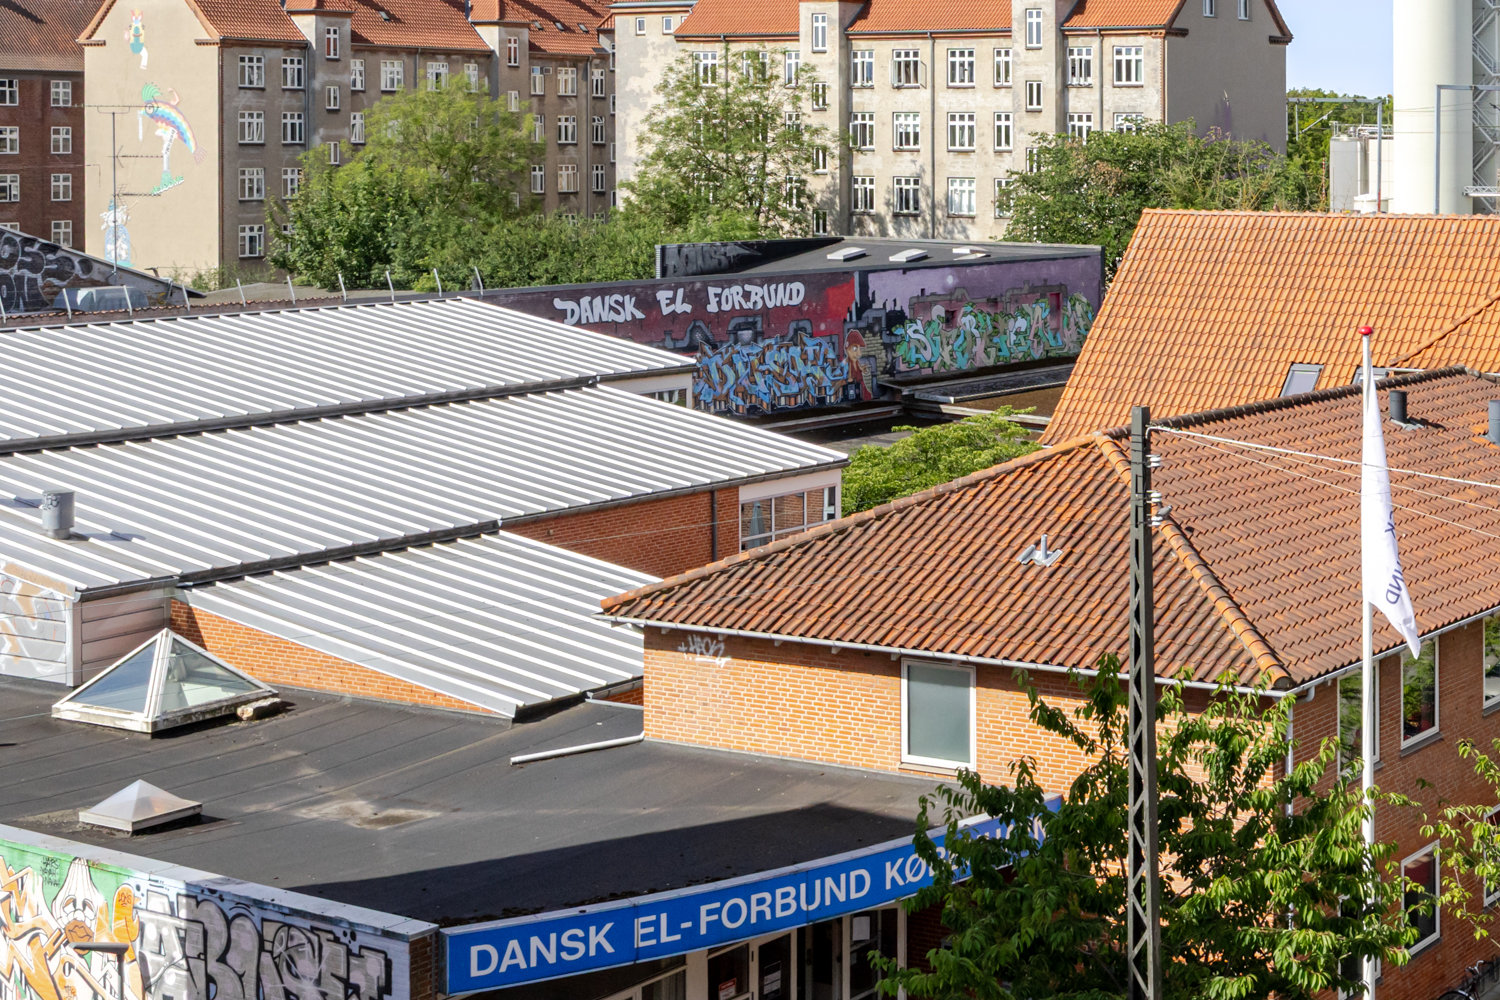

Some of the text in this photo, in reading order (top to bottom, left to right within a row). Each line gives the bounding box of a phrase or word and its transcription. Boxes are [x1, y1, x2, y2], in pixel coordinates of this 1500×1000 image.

[553, 281, 805, 326] DANSK EL FORBUND
[470, 922, 615, 978] DANSK
[634, 868, 871, 949] EL-FORBUND
